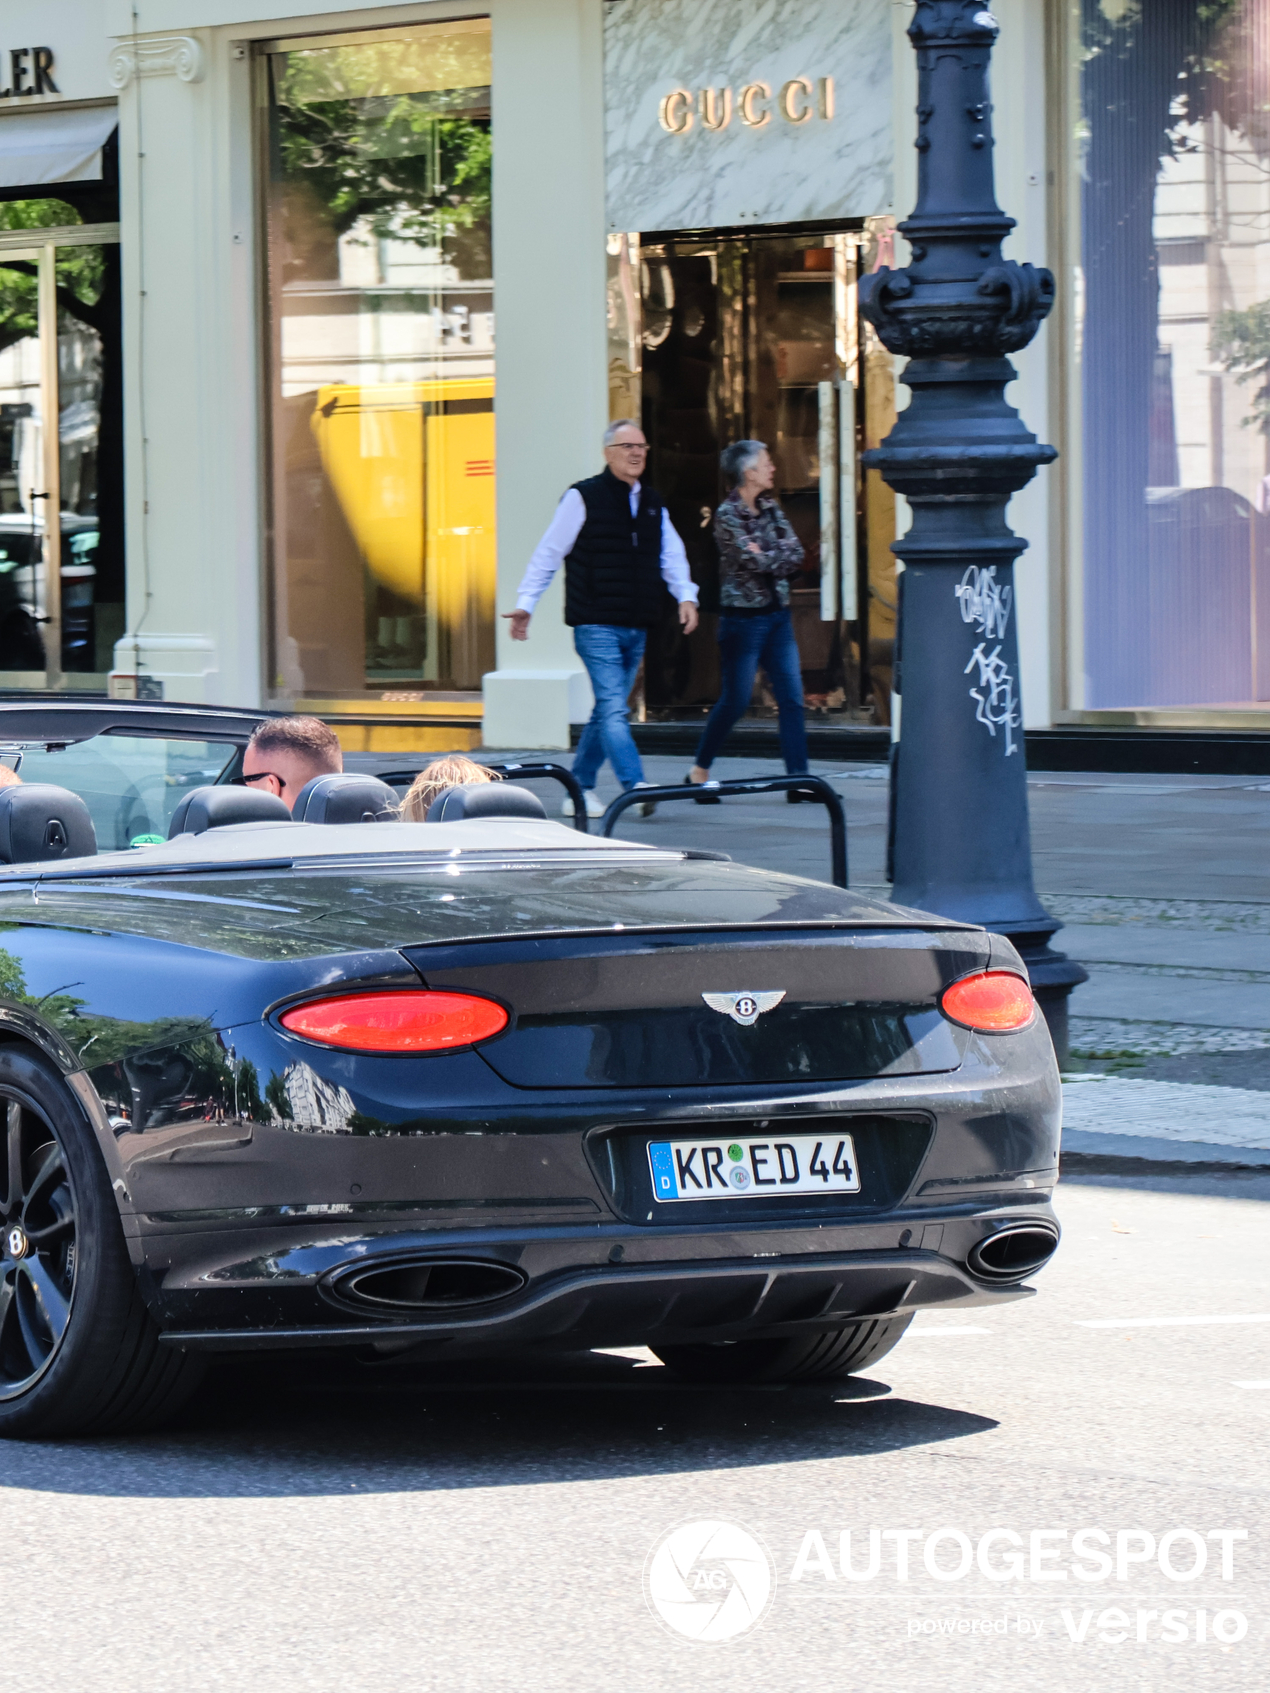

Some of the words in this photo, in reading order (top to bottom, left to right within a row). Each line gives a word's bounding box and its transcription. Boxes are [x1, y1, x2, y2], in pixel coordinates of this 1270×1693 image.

[658, 77, 835, 133] GUCCI
[660, 1176, 671, 1190] D
[675, 1146, 730, 1190] KR
[748, 1143, 801, 1186] ED
[809, 1140, 853, 1183] 44
